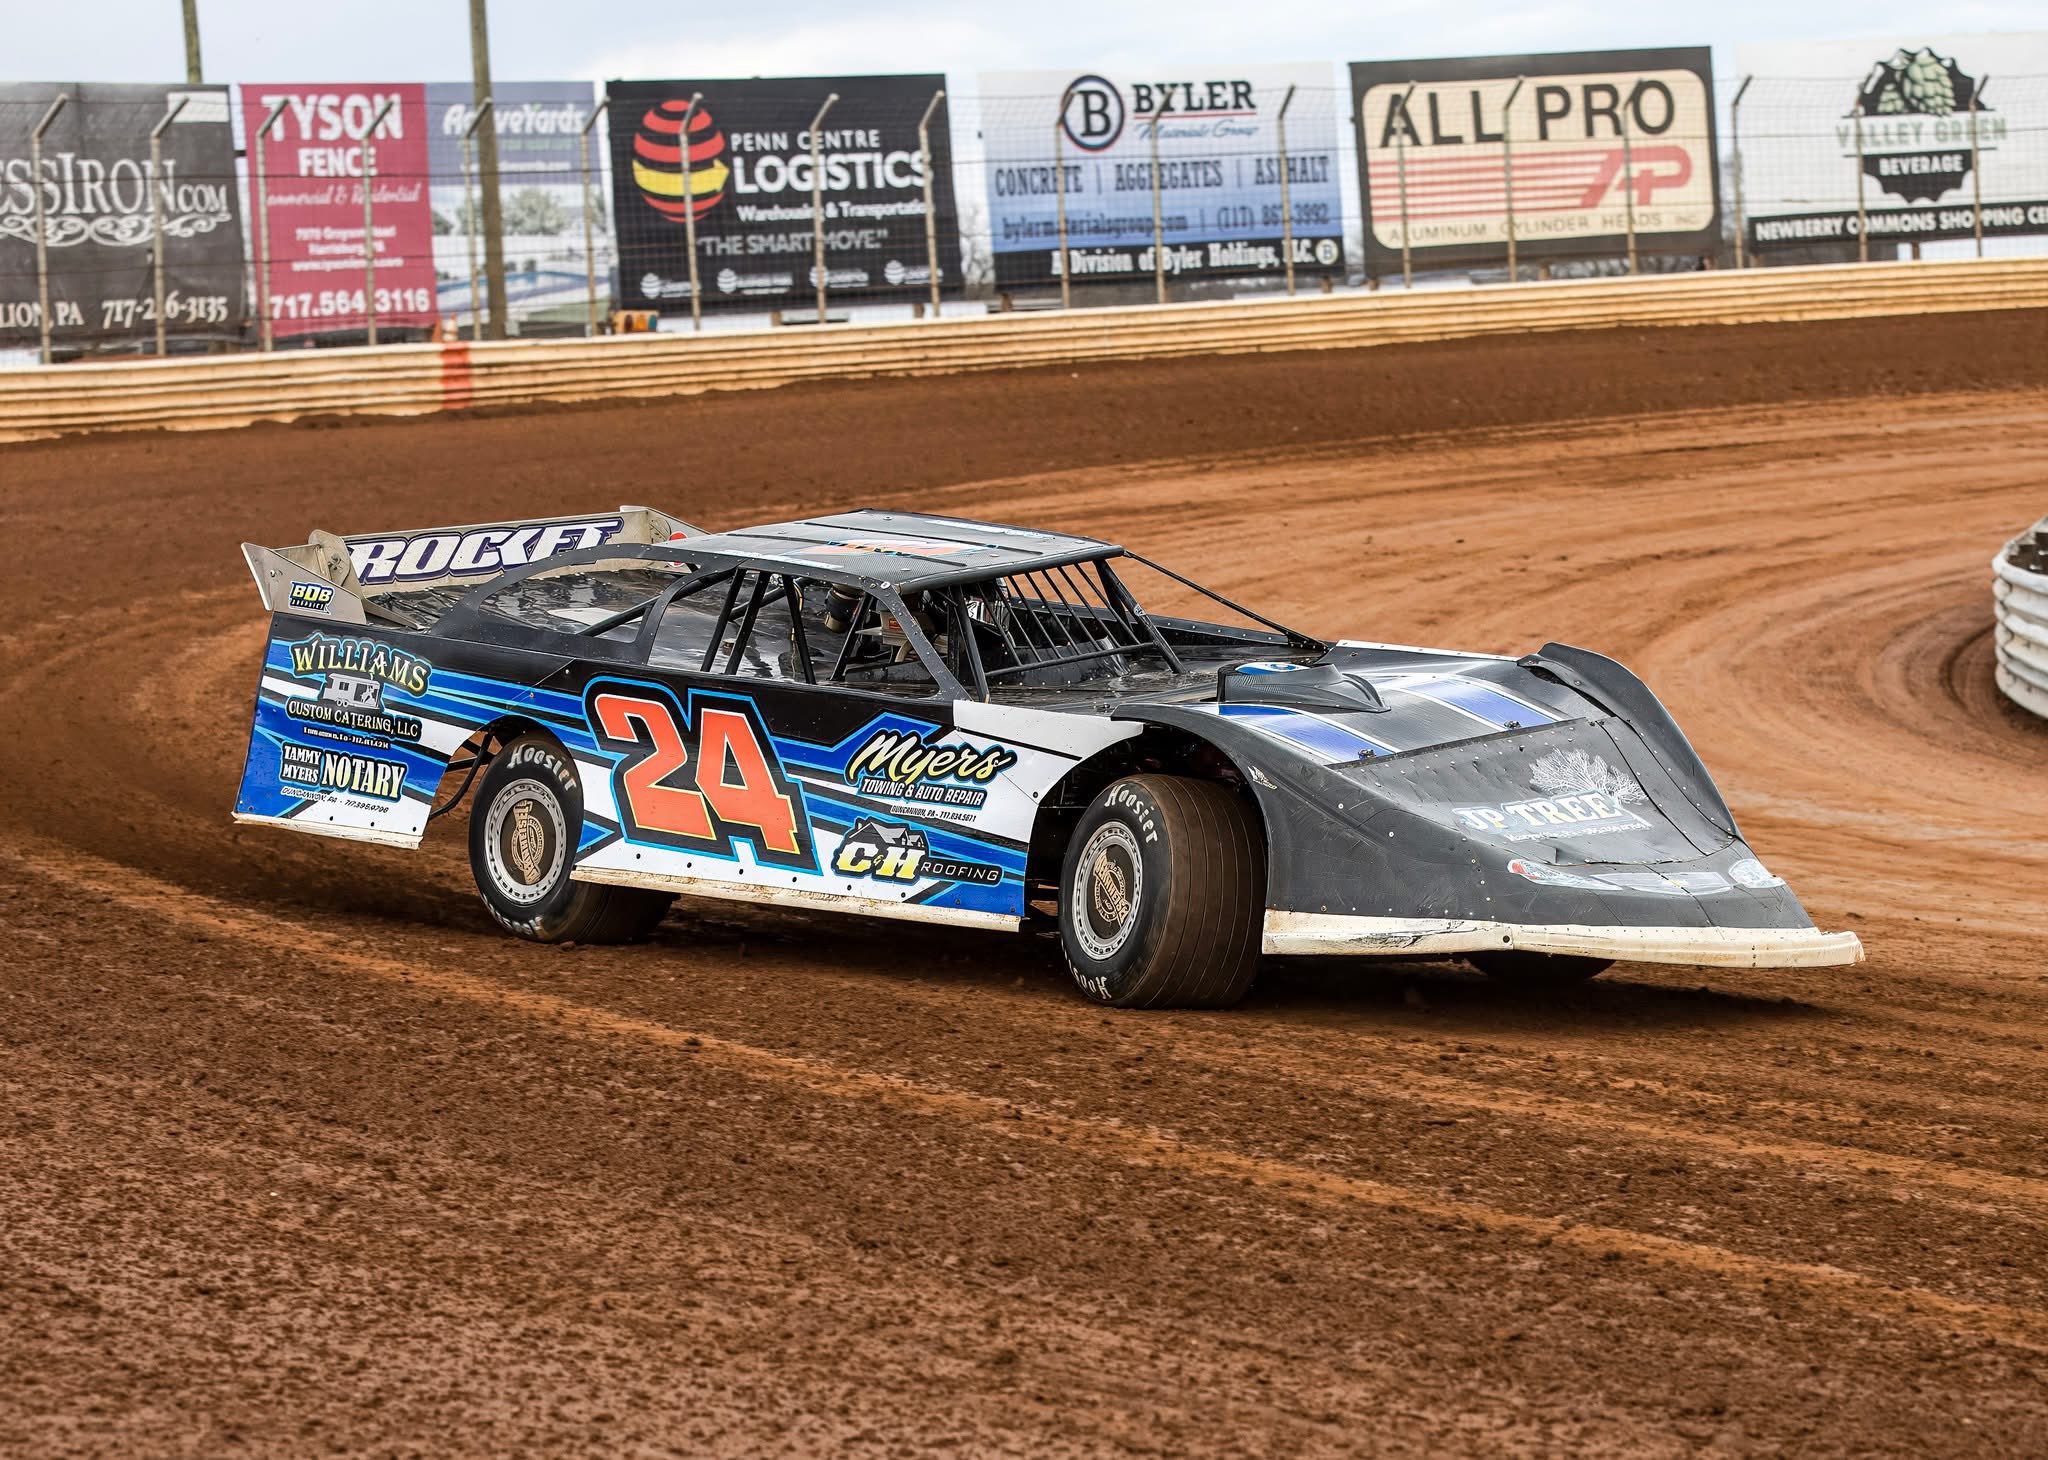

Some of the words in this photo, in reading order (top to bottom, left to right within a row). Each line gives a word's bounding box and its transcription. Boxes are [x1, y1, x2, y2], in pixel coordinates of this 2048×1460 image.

[1079, 89, 1112, 138] B
[1131, 80, 1257, 114] BYLER
[1380, 88, 1505, 148] ALL
[1535, 79, 1675, 141] PRO
[260, 93, 404, 141] TYSON
[731, 131, 789, 151] PENN
[797, 129, 881, 150] CENTRE
[1835, 121, 1924, 148] VALLEY
[298, 146, 378, 177] FENCE
[732, 150, 934, 194] LOGISTICS
[1878, 154, 1964, 176] BEVERAGE
[995, 165, 1084, 197] CONCRETE
[825, 201, 839, 219] &
[1755, 215, 1844, 241] NEWBERRY
[1939, 207, 2025, 231] SHOPING
[747, 231, 815, 254] SMART
[1389, 223, 1486, 243] AUMINUM
[1069, 248, 1134, 274] Division
[1138, 246, 1157, 272] of
[1161, 244, 1203, 275] Byler
[1207, 241, 1280, 270] Holdings,
[55, 301, 85, 327] PA
[102, 290, 229, 329] 717-26-3135
[270, 287, 431, 320] 717.5643116
[292, 584, 333, 602] BOB
[294, 638, 428, 693] WILLIAMS
[288, 700, 332, 722] CUSTOM
[334, 709, 396, 735] CATERING,
[397, 719, 419, 738] LLC
[284, 745, 322, 766] TAMMY
[849, 734, 1012, 785] Myers
[282, 764, 320, 784] MYERS
[321, 752, 405, 798] NOTARY
[595, 693, 801, 855] 24
[861, 778, 905, 797] TOWING
[905, 784, 914, 798] &
[915, 785, 944, 802] AUTO
[944, 788, 985, 806] REPAIR
[1456, 808, 1509, 831] JP
[1505, 792, 1625, 827] TREE
[920, 861, 999, 882] ROOFING
